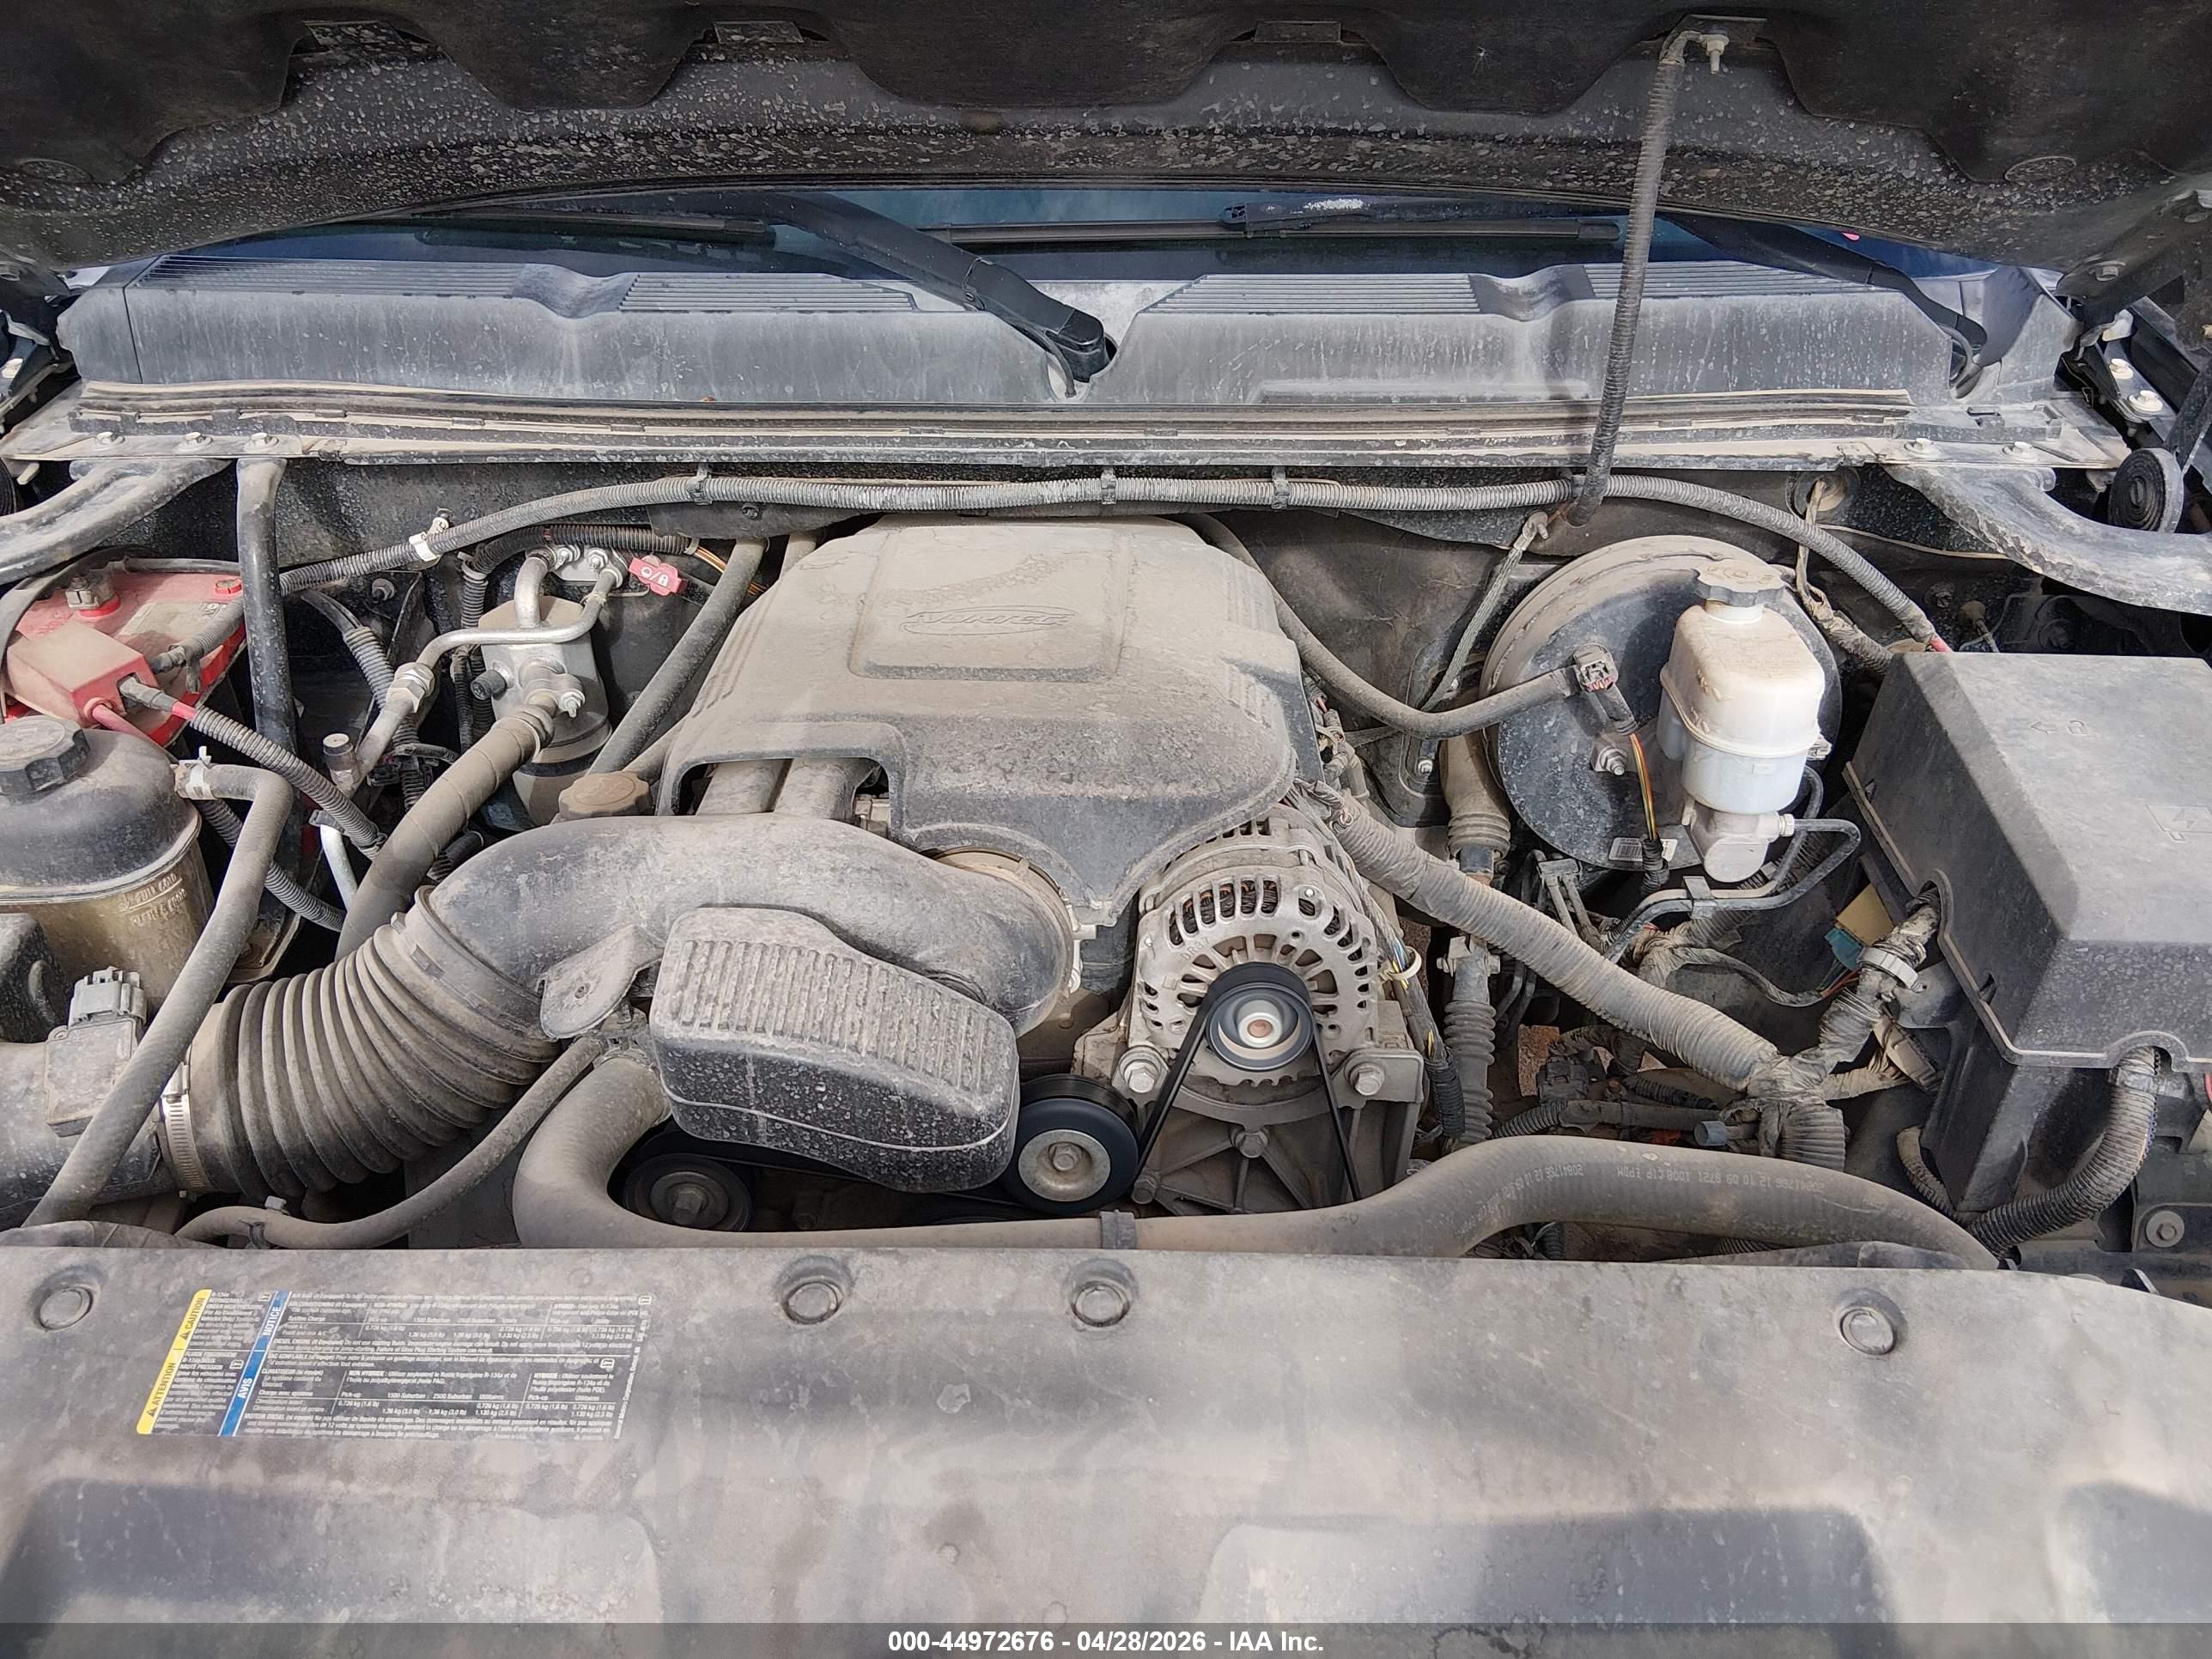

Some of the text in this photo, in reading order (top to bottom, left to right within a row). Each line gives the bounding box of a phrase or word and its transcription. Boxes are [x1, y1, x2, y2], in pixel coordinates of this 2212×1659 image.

[185, 1297, 206, 1330] CAUTION
[262, 1305, 282, 1336] NOTICE
[155, 1362, 176, 1406] ATTENTION
[237, 1377, 252, 1400] AVIS
